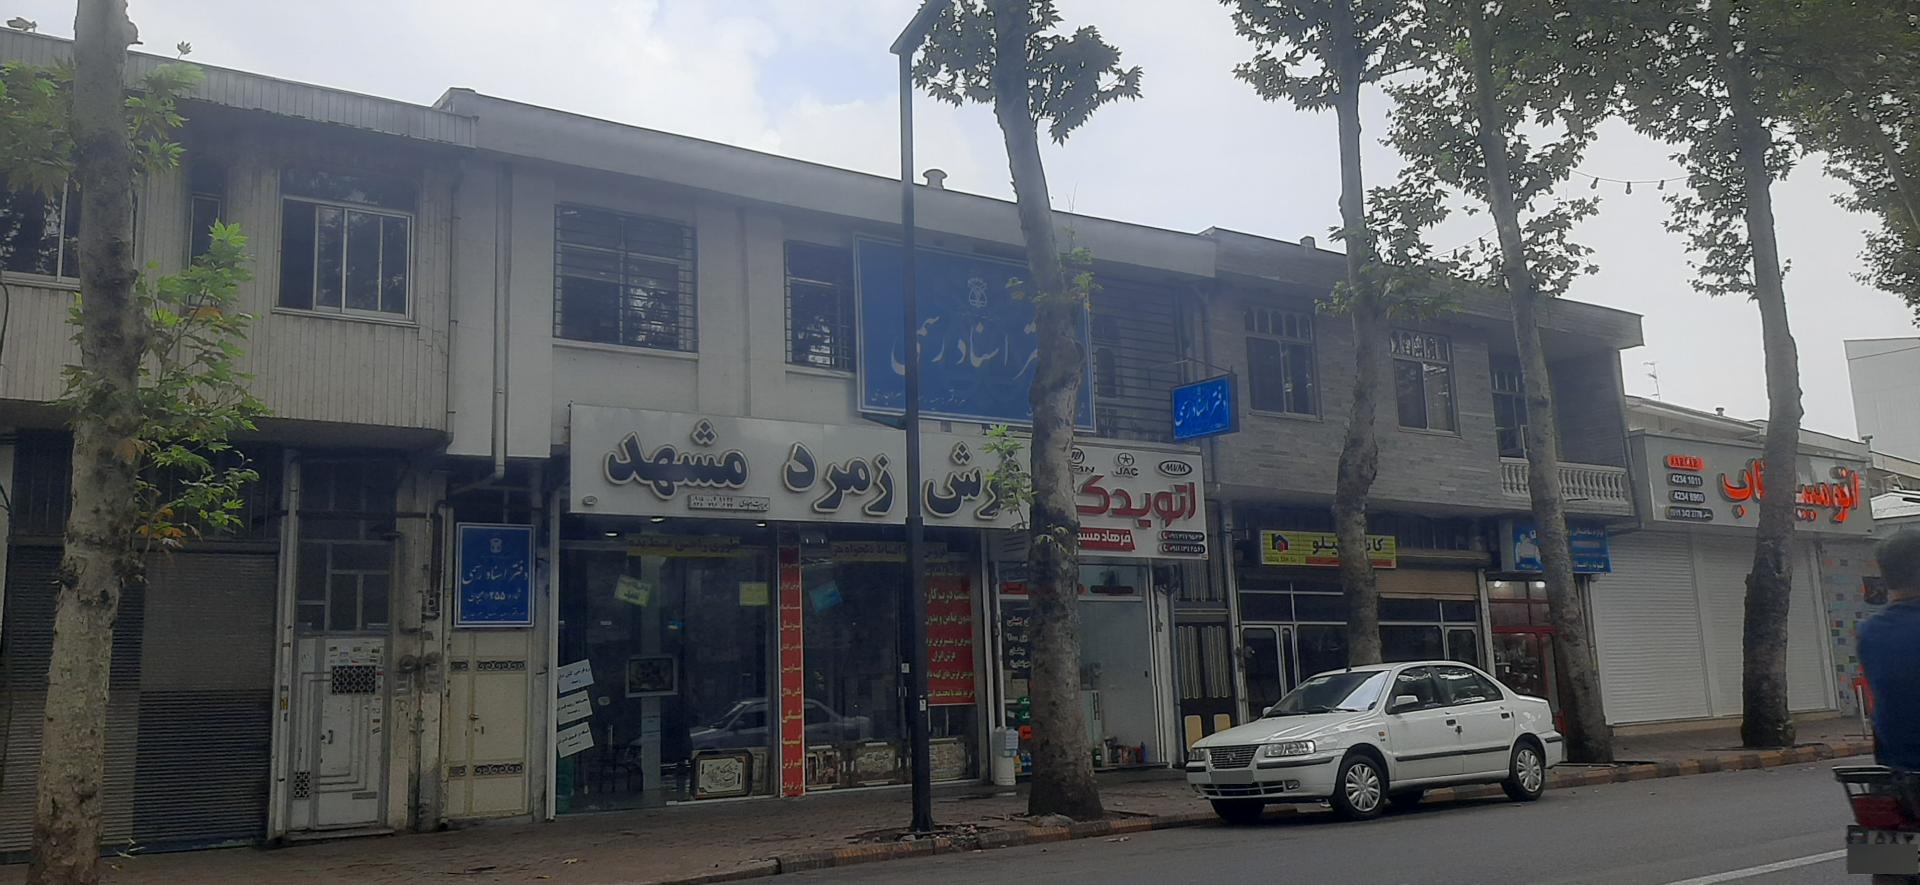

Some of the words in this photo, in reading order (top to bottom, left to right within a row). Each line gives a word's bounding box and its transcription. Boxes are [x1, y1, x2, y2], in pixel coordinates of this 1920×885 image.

[955, 323, 1009, 368] اسناد
[1192, 398, 1209, 416] اسناد
[1211, 386, 1226, 416] دفتر
[1174, 401, 1190, 426] رسمی
[606, 418, 751, 501] مشهد
[1165, 462, 1187, 473] MVM
[782, 439, 898, 516] زمرد
[1115, 466, 1139, 477] JAC
[1101, 530, 1131, 545] فرهاد
[462, 564, 483, 585] رسمی
[487, 565, 507, 581] اسناد
[507, 560, 528, 583] دفتر
